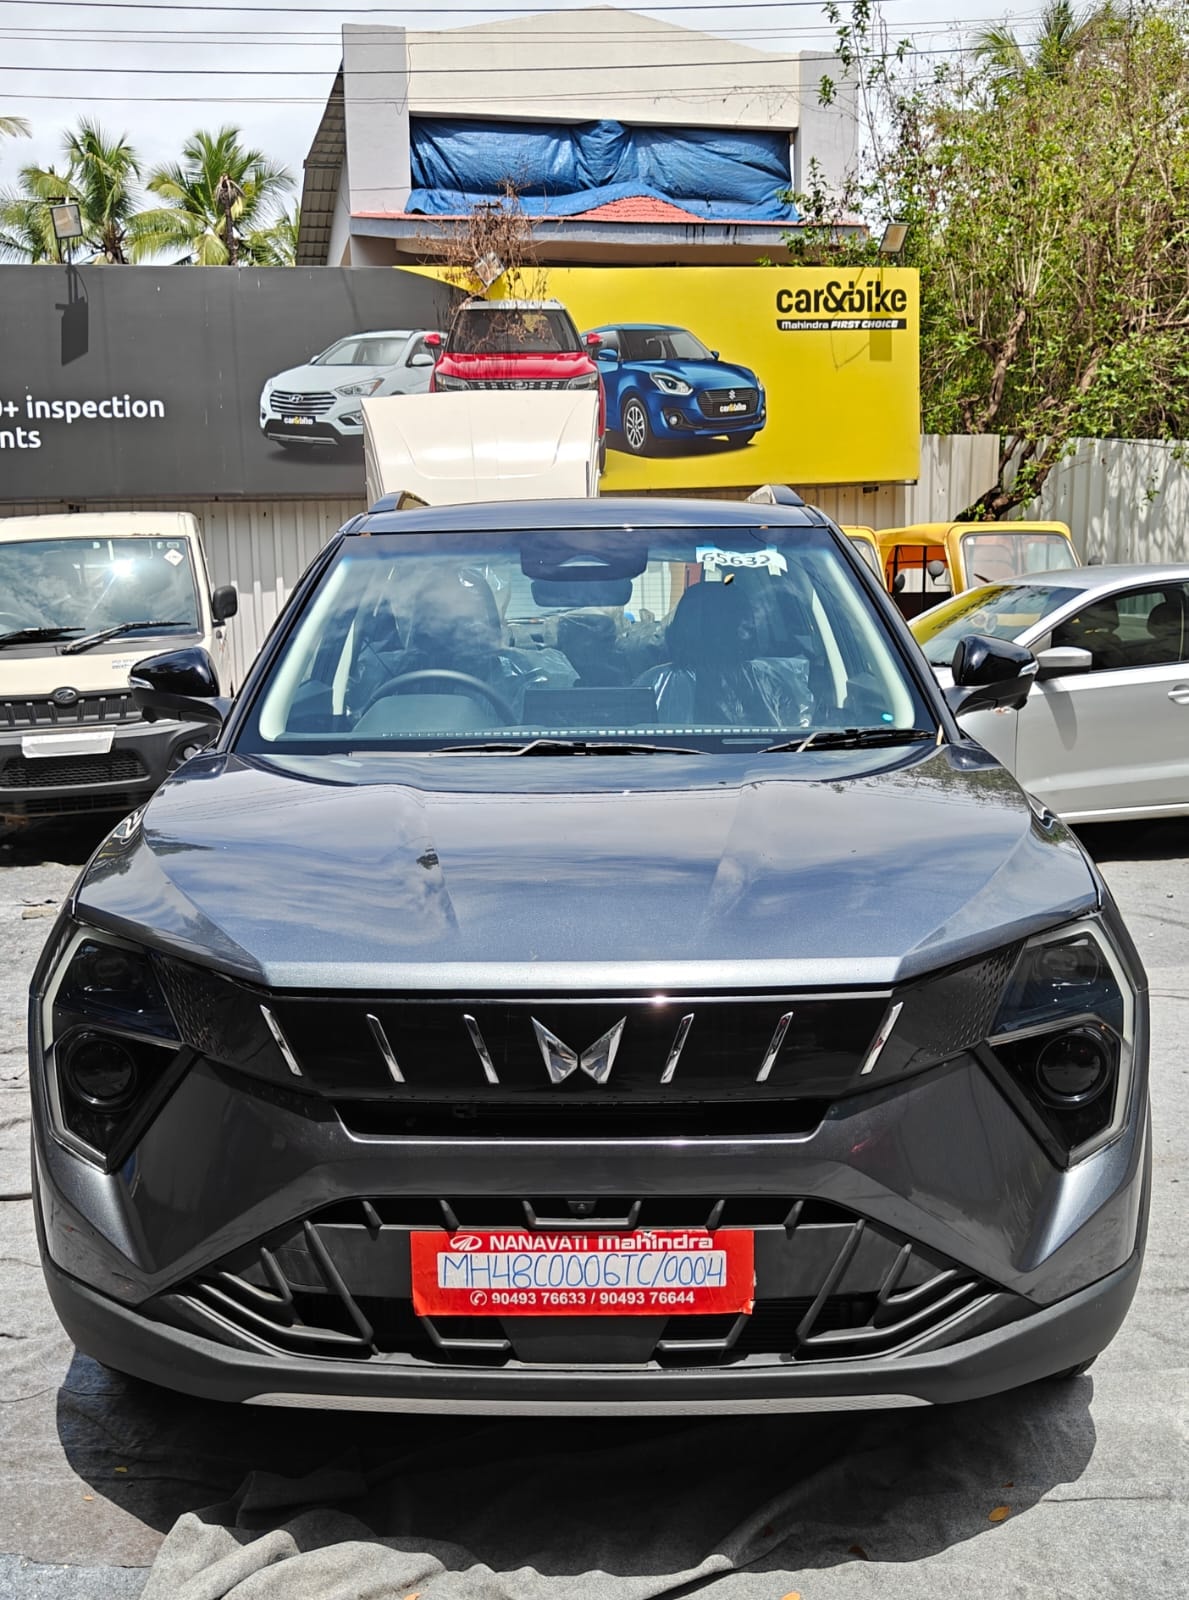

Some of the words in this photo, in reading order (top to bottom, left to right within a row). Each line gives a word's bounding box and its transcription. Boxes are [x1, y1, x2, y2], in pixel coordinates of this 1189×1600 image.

[776, 280, 907, 314] car&bike
[830, 320, 860, 329] FIRST
[861, 320, 899, 329] CHOICE
[26, 394, 165, 424] inspection
[490, 1235, 588, 1250] NANAVATI
[491, 1293, 537, 1304] 90493
[541, 1293, 587, 1304] 76633
[600, 1293, 645, 1304] 90493
[650, 1291, 695, 1304] 76644
